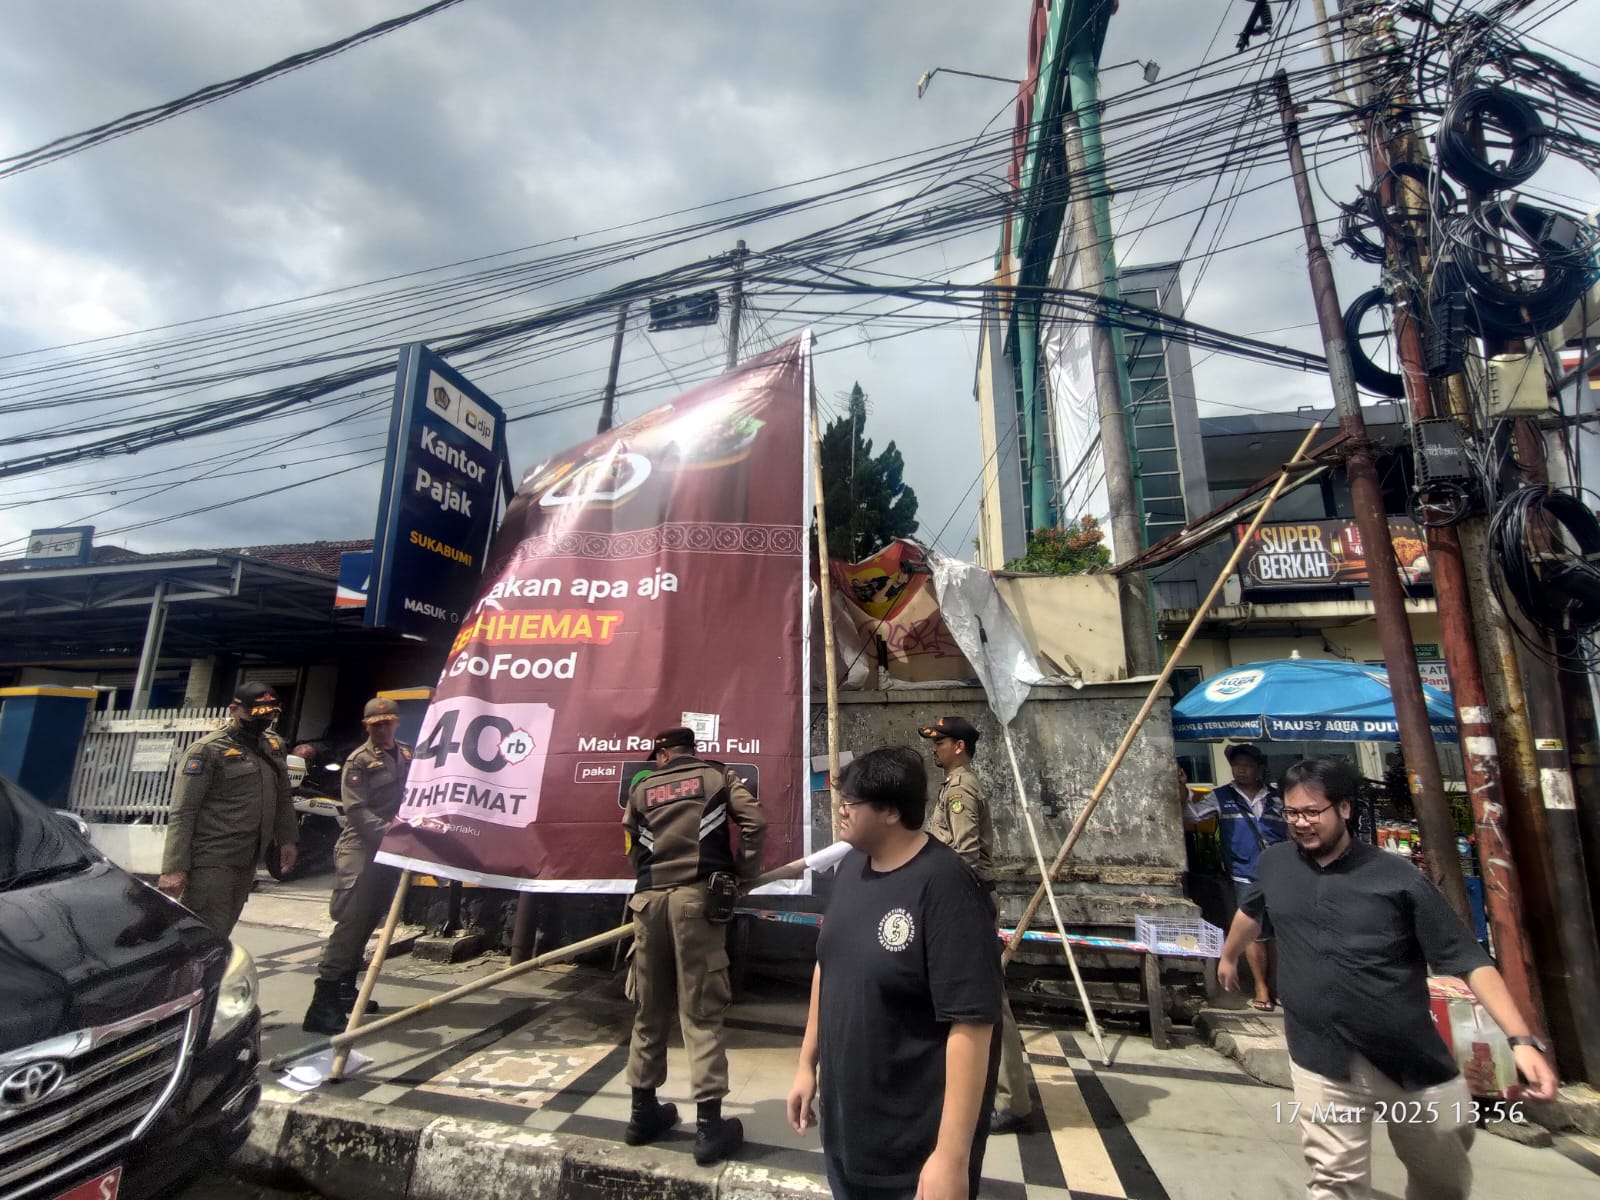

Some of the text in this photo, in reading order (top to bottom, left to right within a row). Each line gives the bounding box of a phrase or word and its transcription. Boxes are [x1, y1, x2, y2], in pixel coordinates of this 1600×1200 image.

[477, 419, 491, 439] djp
[420, 425, 487, 482] Kantor
[415, 467, 472, 518] Pajak
[409, 530, 472, 567] SUKABUMI
[1261, 525, 1324, 554] SUPER
[1258, 552, 1330, 580] BERKAH
[570, 578, 628, 604] apa
[637, 567, 678, 600] aja
[404, 597, 447, 620] MASUK
[449, 651, 577, 680] GoFood
[1217, 675, 1257, 687] AQUA
[1272, 720, 1322, 732] HAUS?
[1325, 720, 1360, 733] AQUA
[414, 709, 514, 773] 40
[506, 739, 527, 754] rb
[577, 737, 621, 752] Mau
[726, 738, 760, 754] Full
[582, 765, 617, 779] pakai
[646, 778, 700, 808] POL-PP
